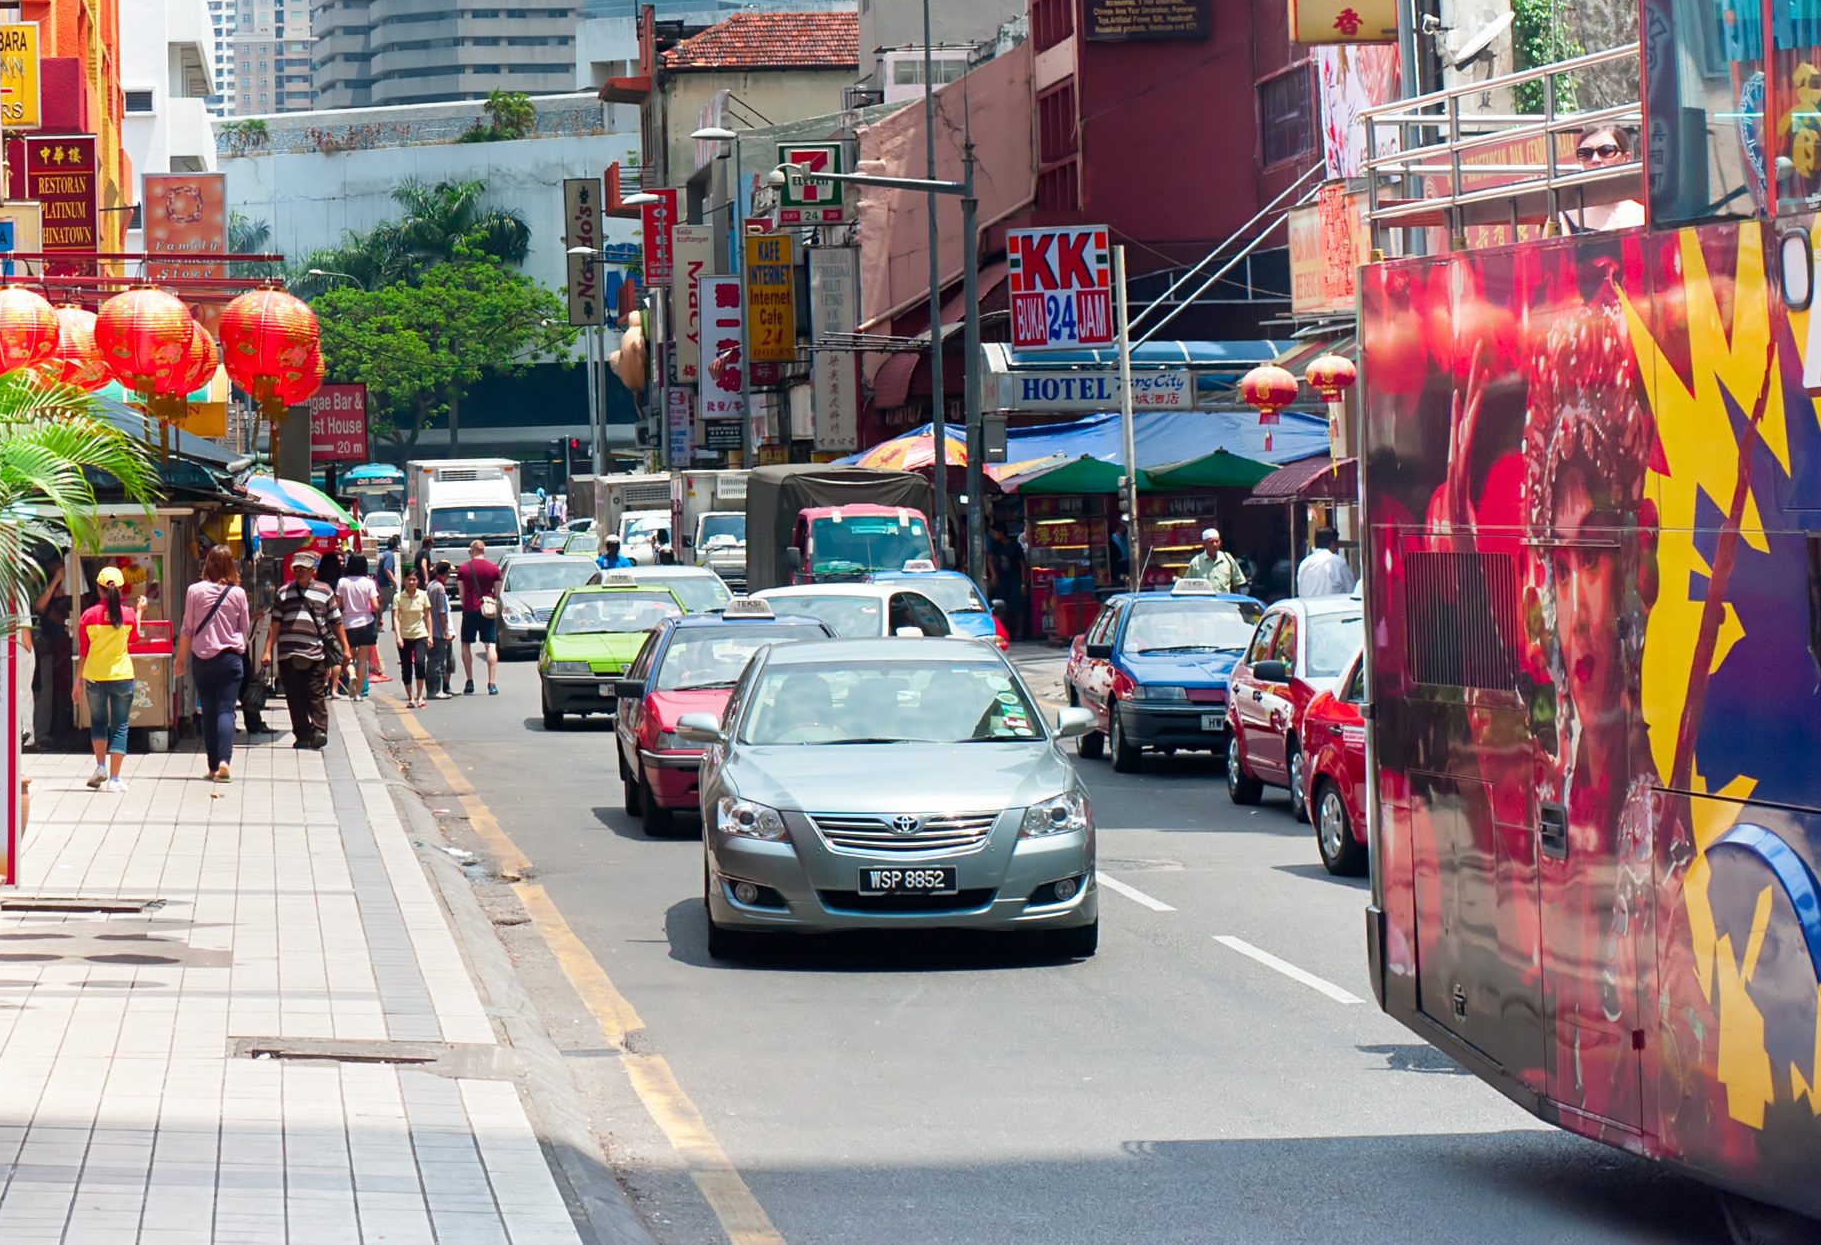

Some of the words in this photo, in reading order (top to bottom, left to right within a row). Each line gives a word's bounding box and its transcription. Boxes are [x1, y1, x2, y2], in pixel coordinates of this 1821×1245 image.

[38, 176, 86, 195] RESTORAN
[804, 211, 819, 221] 24
[155, 240, 218, 252] Family
[757, 241, 781, 262] KAFE
[1021, 232, 1096, 291] KK
[749, 264, 791, 286] INTERNET
[750, 290, 791, 306] Internet
[759, 307, 784, 326] Cafe
[1018, 297, 1046, 340] BUKA
[1048, 294, 1076, 341] 24
[1079, 295, 1108, 338] JAM
[762, 329, 784, 346] 24
[1021, 377, 1112, 401] HOTEL
[1154, 373, 1185, 392] City
[333, 392, 352, 410] Bar
[354, 392, 363, 410] &
[327, 417, 363, 434] House
[337, 442, 351, 454] 20
[353, 444, 363, 454] m
[736, 599, 762, 607] TEKSI
[869, 869, 902, 888] WSP
[904, 869, 945, 888] 8852
